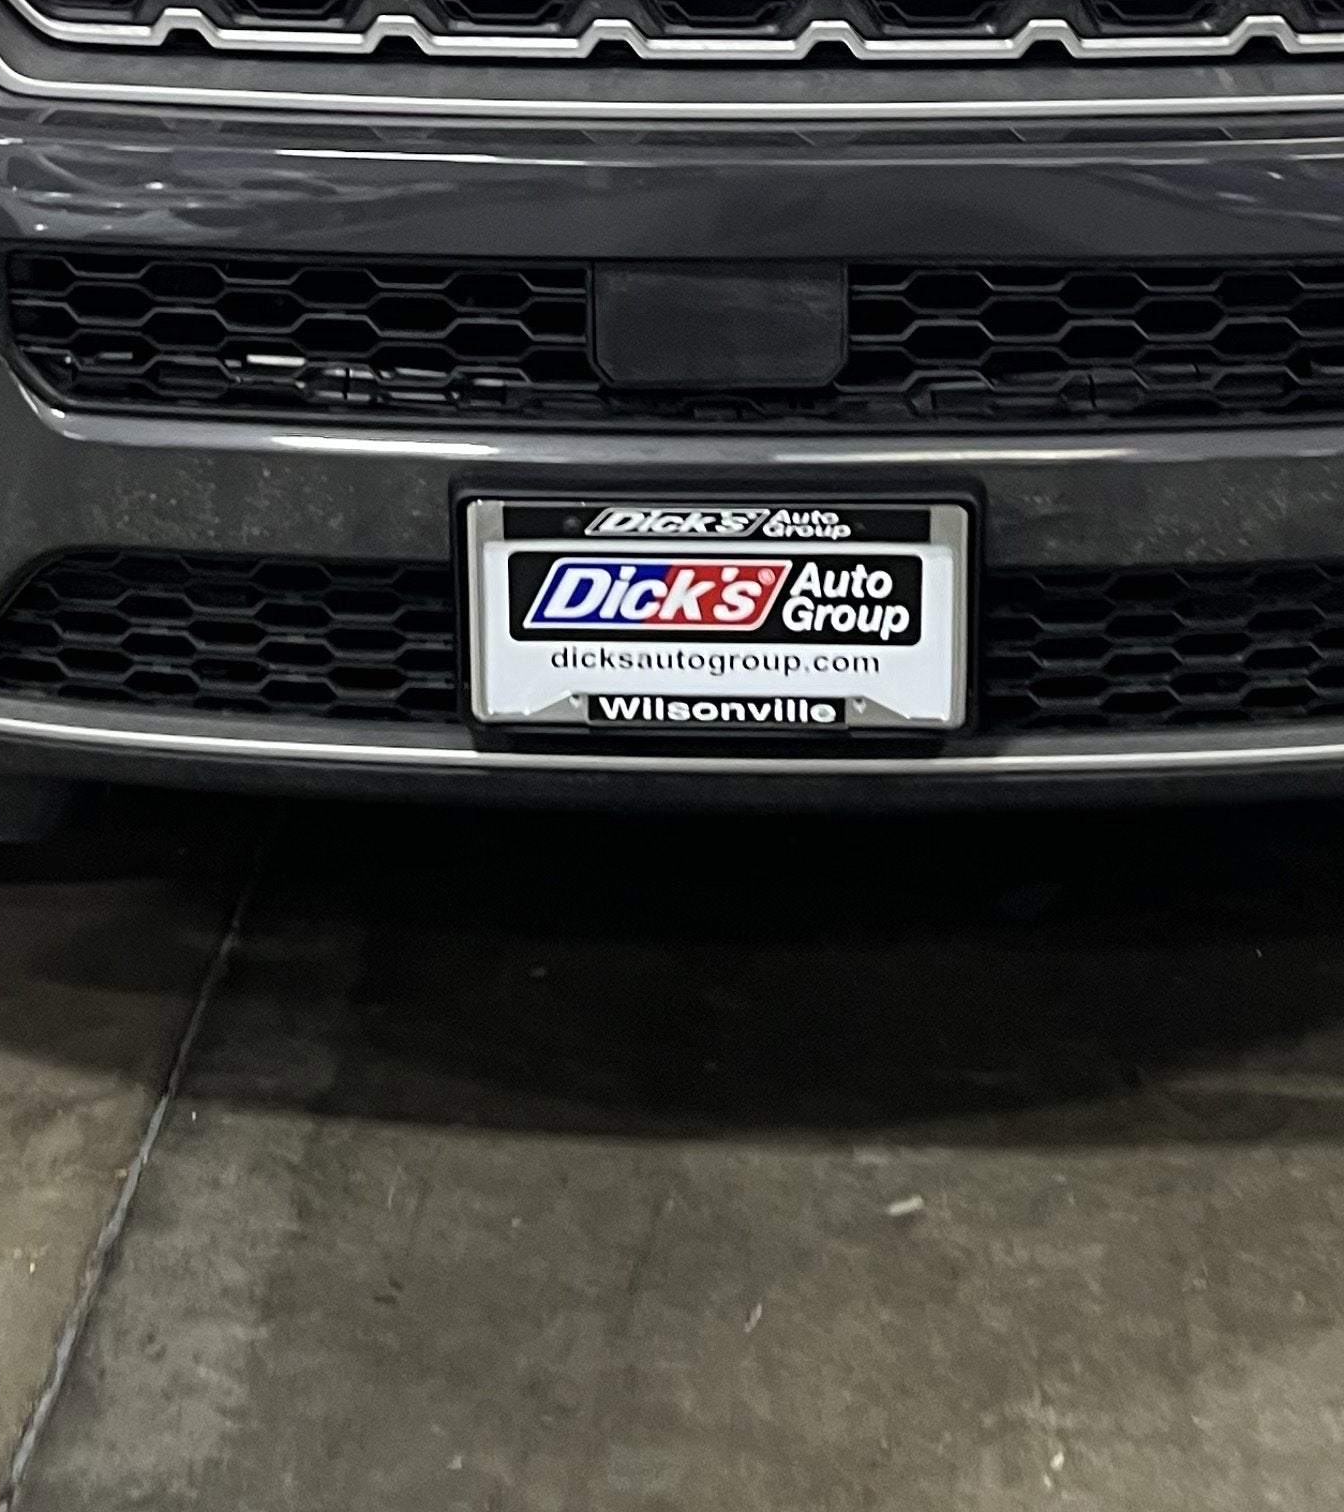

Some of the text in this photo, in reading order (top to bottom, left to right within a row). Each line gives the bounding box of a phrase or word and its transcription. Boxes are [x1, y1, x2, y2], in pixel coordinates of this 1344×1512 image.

[762, 522, 851, 539] Group
[771, 509, 839, 524] Auto
[791, 561, 893, 599] Auto
[782, 596, 910, 641] Group
[551, 647, 880, 676] dicksautogroup.com
[598, 696, 837, 723] Wilsonville
